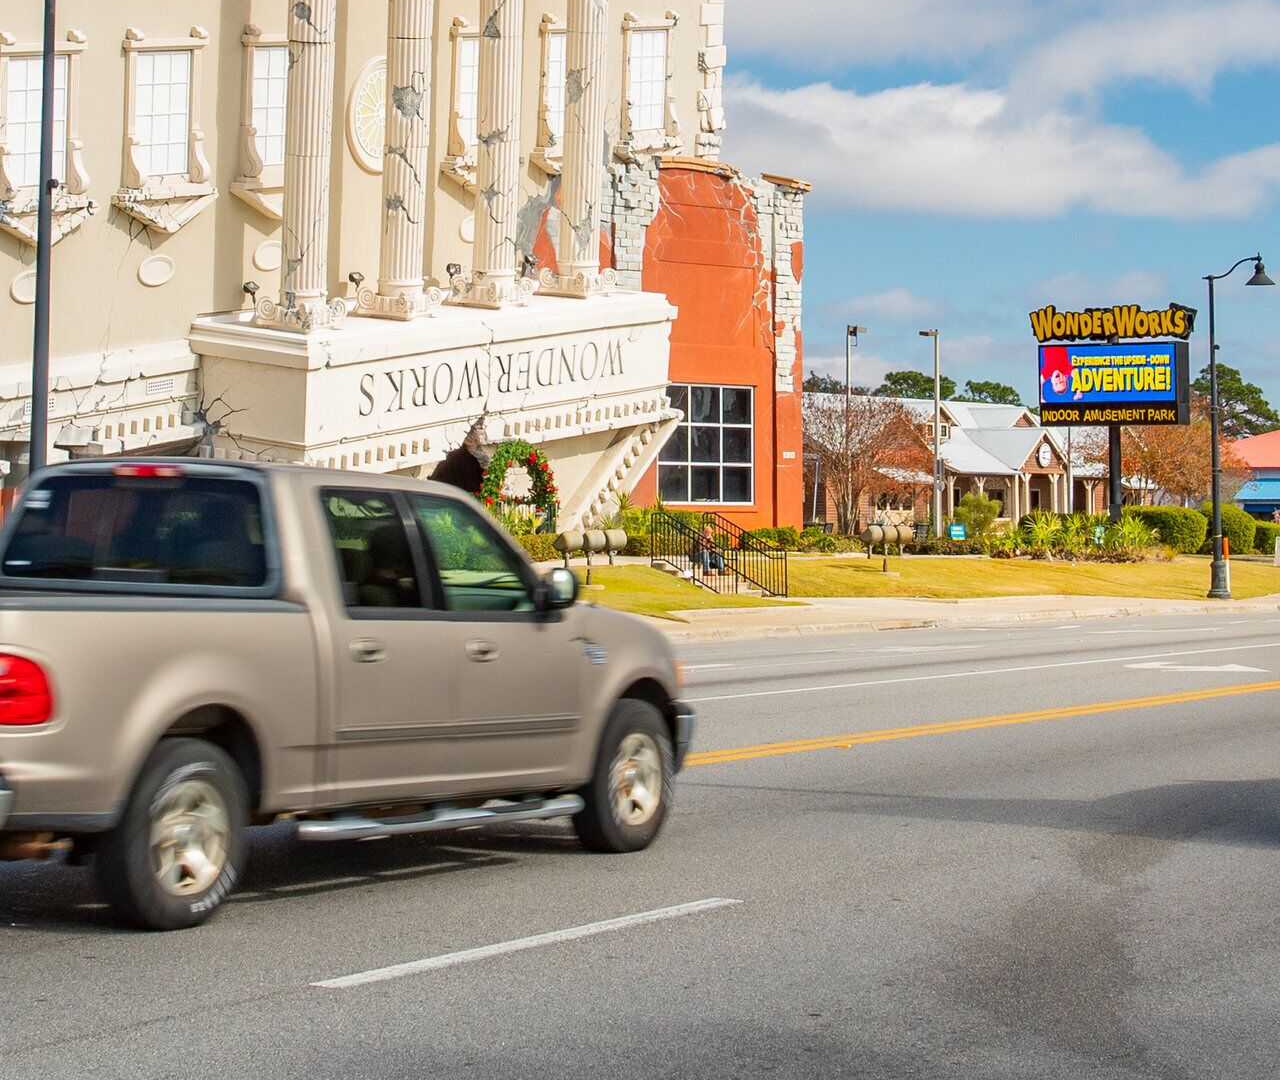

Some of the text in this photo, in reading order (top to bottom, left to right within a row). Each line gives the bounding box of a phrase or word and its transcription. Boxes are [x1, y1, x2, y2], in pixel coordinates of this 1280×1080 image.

[1070, 367, 1172, 392] ADVENTURE!
[1042, 408, 1176, 422] INDOOR AMUSEMENT PARK
